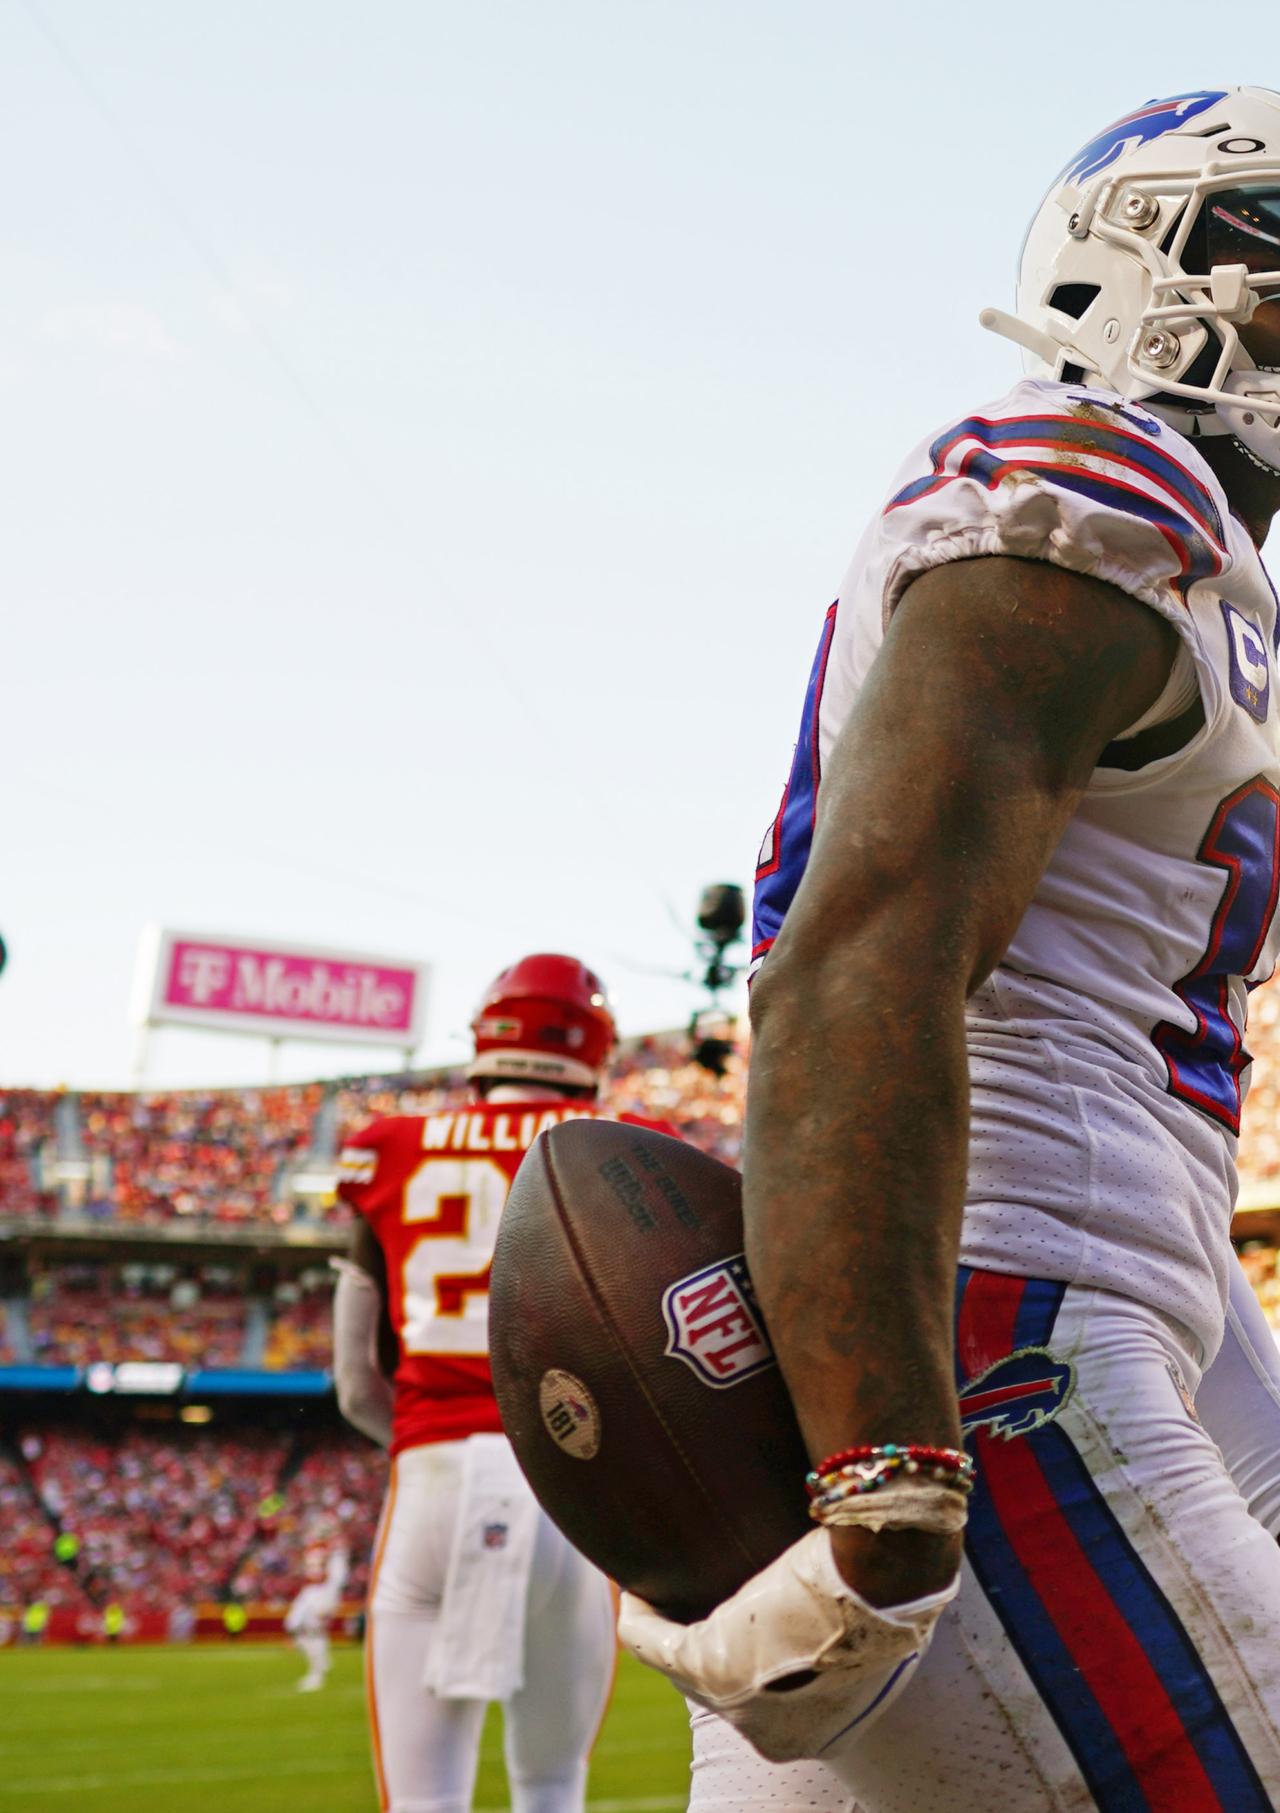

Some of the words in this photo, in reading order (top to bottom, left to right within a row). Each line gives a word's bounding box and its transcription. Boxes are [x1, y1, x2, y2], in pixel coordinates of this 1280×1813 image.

[1230, 610, 1268, 692] C
[234, 955, 405, 1026] Mobile
[402, 1156, 509, 1357] 2
[679, 1275, 762, 1375] NFL
[547, 1401, 577, 1440] 181
